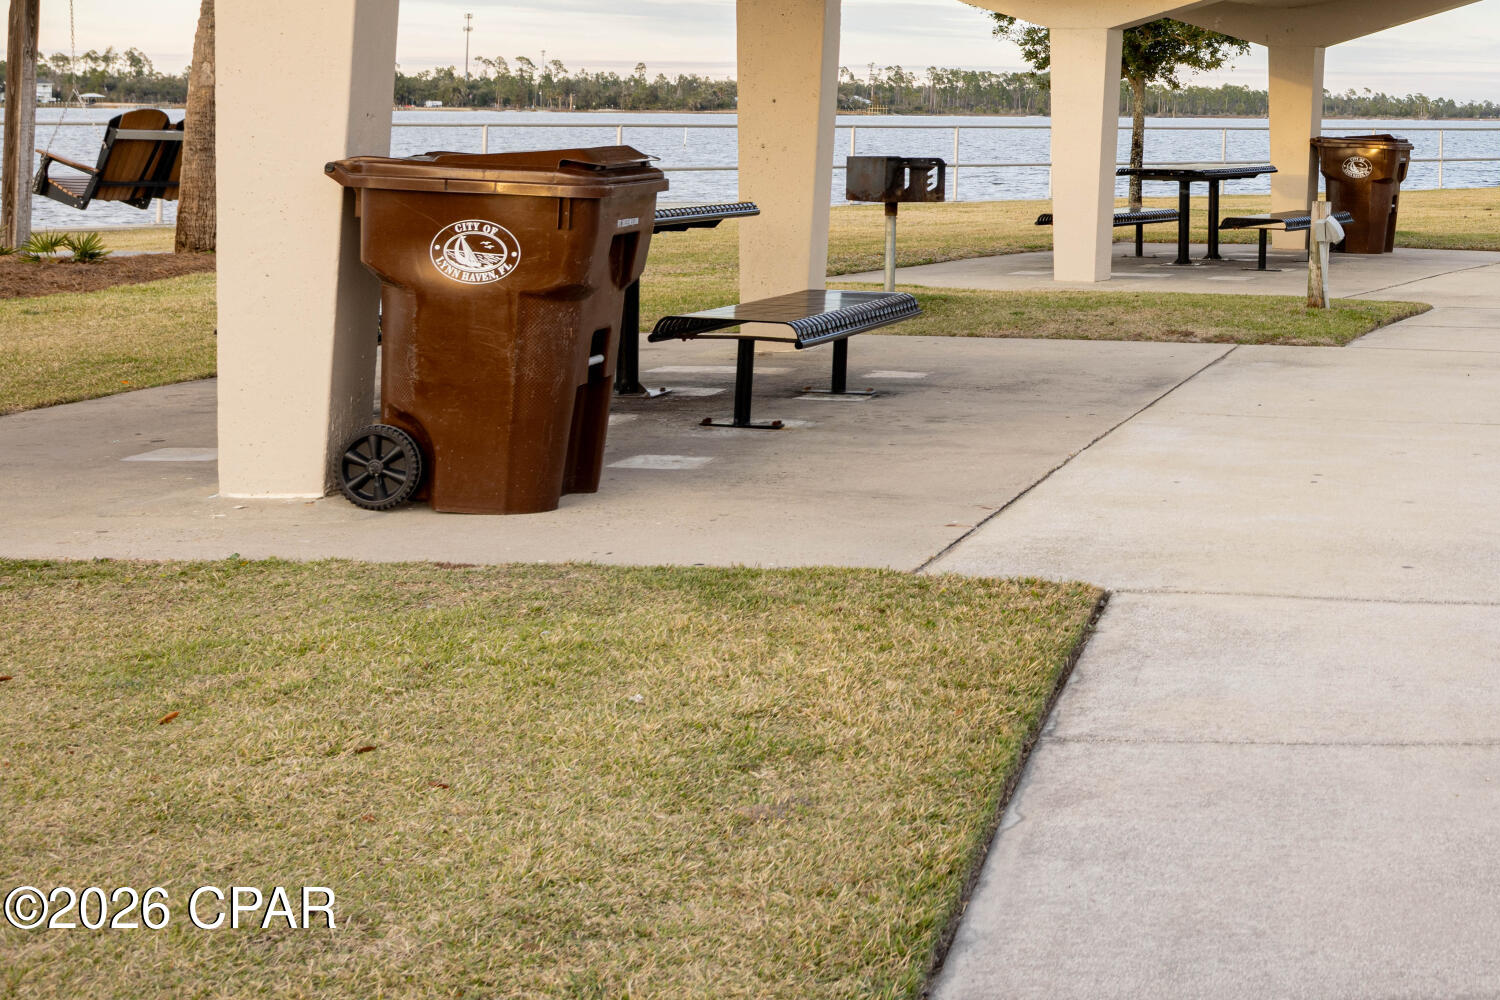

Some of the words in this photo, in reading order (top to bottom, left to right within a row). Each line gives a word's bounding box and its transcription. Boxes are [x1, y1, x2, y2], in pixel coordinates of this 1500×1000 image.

[454, 222, 480, 233] CITY
[482, 224, 499, 236] OF
[435, 256, 461, 278] LYNN
[461, 271, 499, 282] HAVEN,
[498, 262, 513, 275] FL
